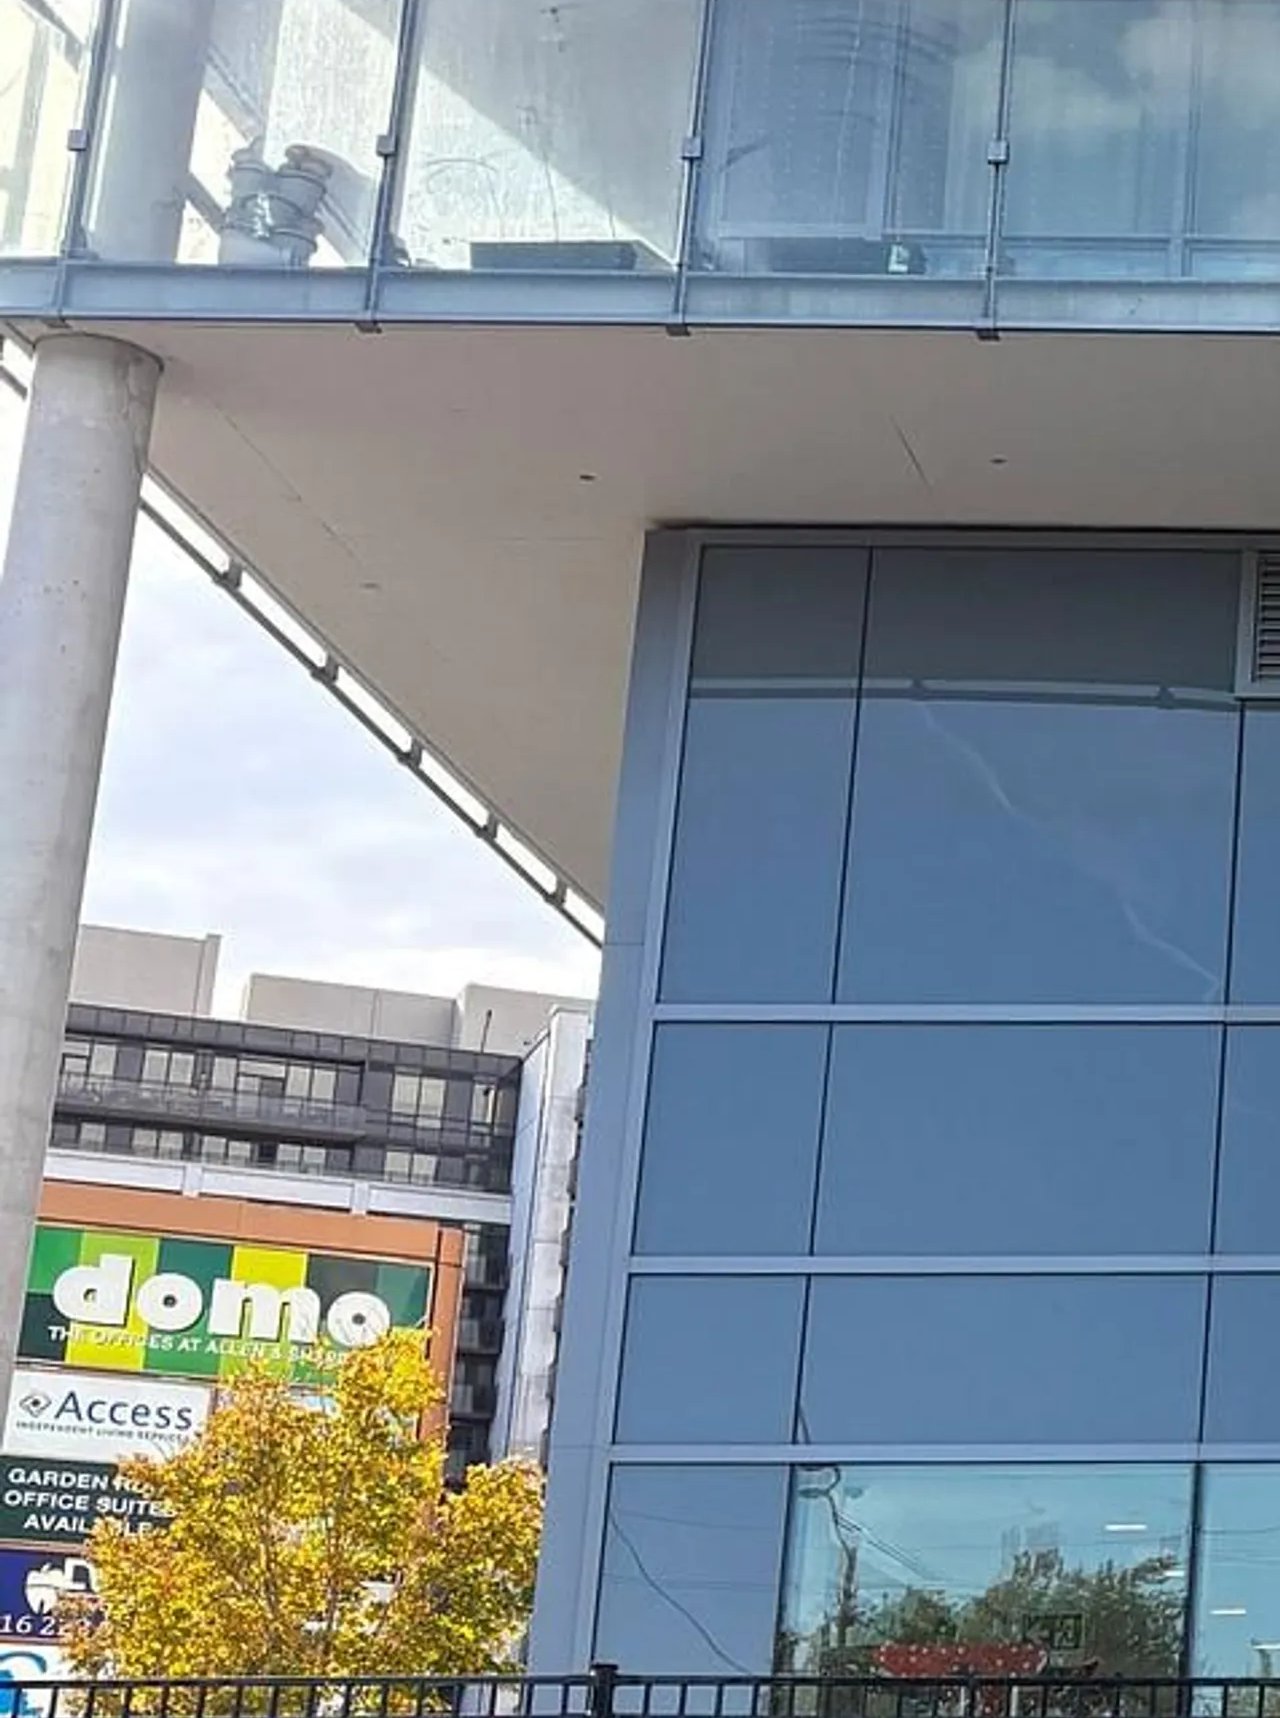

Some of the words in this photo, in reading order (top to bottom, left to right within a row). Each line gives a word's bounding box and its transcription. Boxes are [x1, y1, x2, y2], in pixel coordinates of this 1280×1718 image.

[53, 1253, 391, 1348] domo
[176, 1337, 202, 1353] AT
[205, 1341, 266, 1359] ALLEN
[54, 1389, 193, 1431] Access
[15, 1420, 94, 1435] INDEPENDENT
[96, 1427, 134, 1440] LIVING
[8, 1467, 109, 1492] GARDEN
[3, 1489, 90, 1511] OFFICE
[96, 1495, 178, 1518] SUITES
[23, 1513, 154, 1538] AVAILLE
